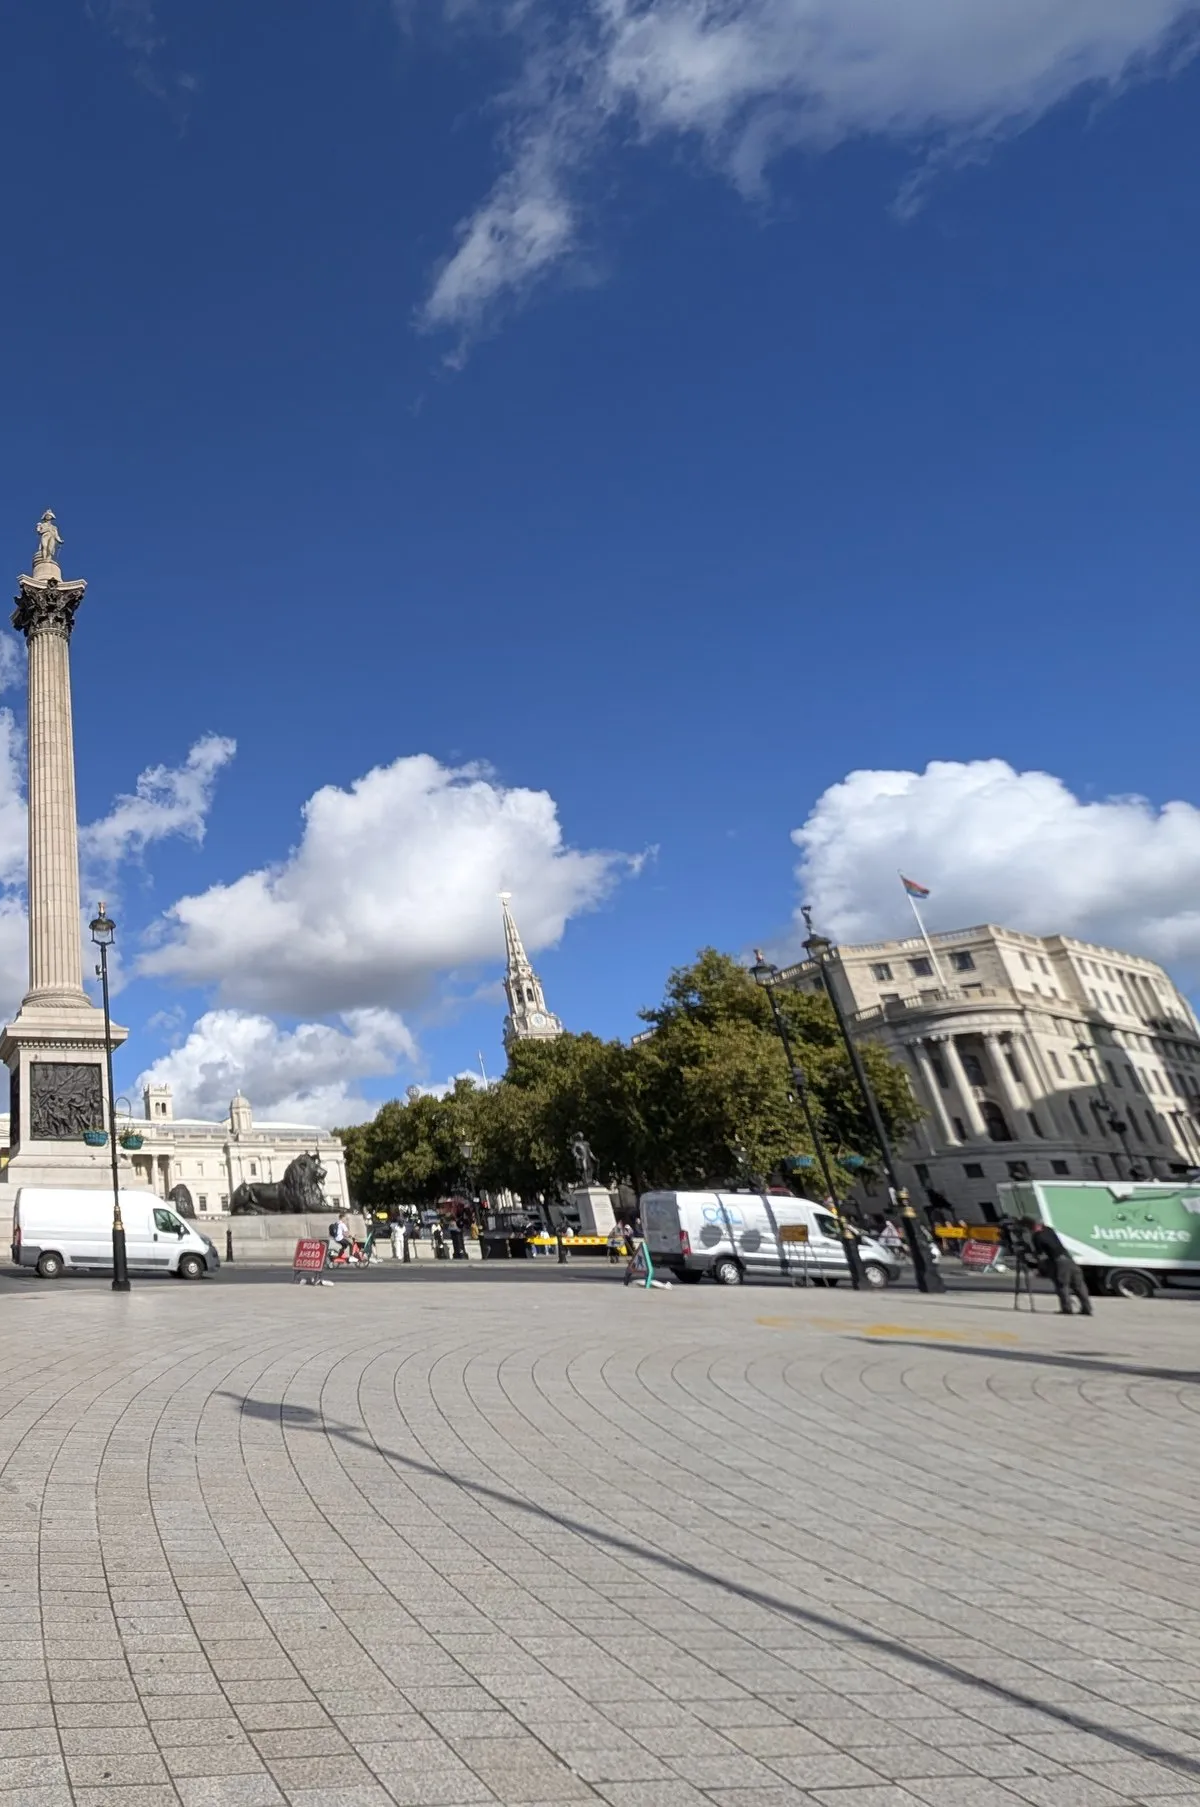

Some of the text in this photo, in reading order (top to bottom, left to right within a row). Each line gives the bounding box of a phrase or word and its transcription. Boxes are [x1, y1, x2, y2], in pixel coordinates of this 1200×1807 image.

[1090, 1225, 1192, 1243] Junkwize
[302, 1242, 321, 1250] ROAD
[299, 1250, 321, 1258] AHEAD
[295, 1259, 321, 1267] CLOSED
